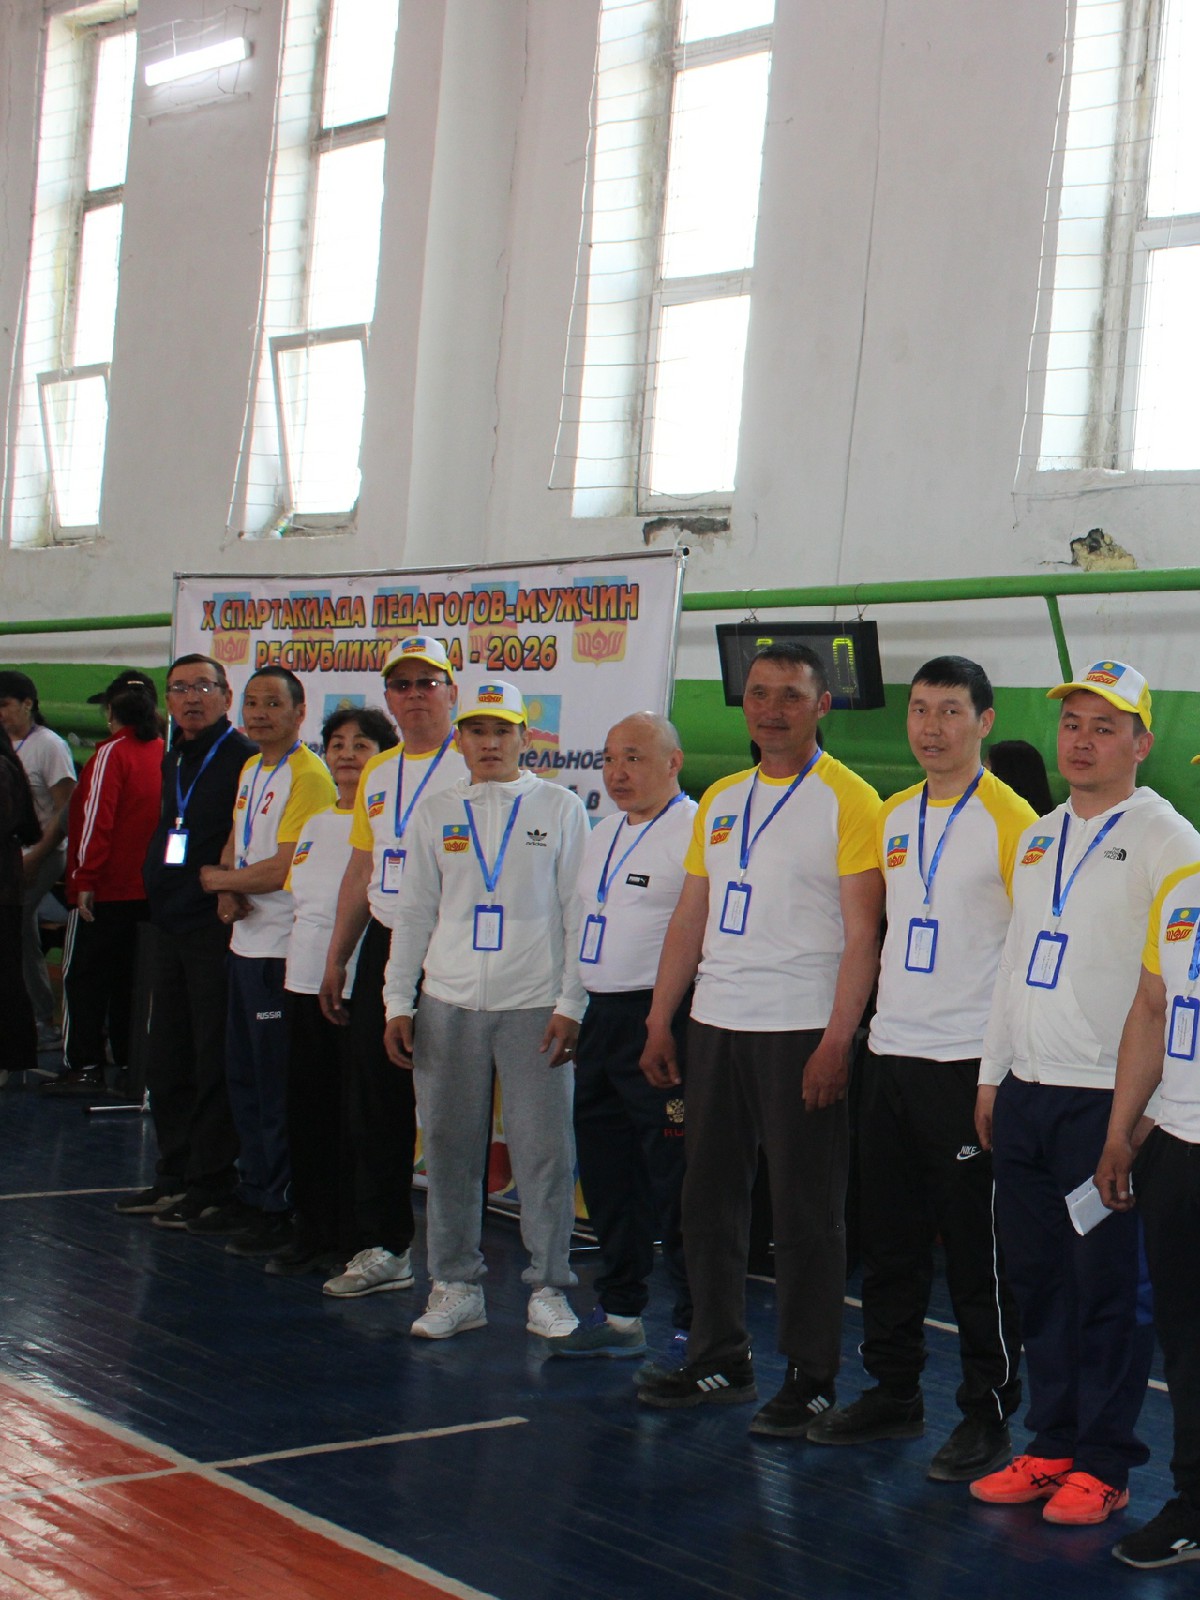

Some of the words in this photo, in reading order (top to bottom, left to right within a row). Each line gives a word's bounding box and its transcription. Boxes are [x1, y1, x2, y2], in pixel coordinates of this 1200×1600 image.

[219, 596, 366, 630] СПАРТАКИАДА
[371, 583, 640, 628] ПЕДАГОГОВ-МУЖЧИН
[255, 637, 392, 672] РЕСПУБЛИКИ
[486, 635, 558, 672] 2026
[261, 791, 274, 815] 2
[256, 1011, 282, 1020] RUSSIA
[960, 1145, 978, 1155] NIKE
